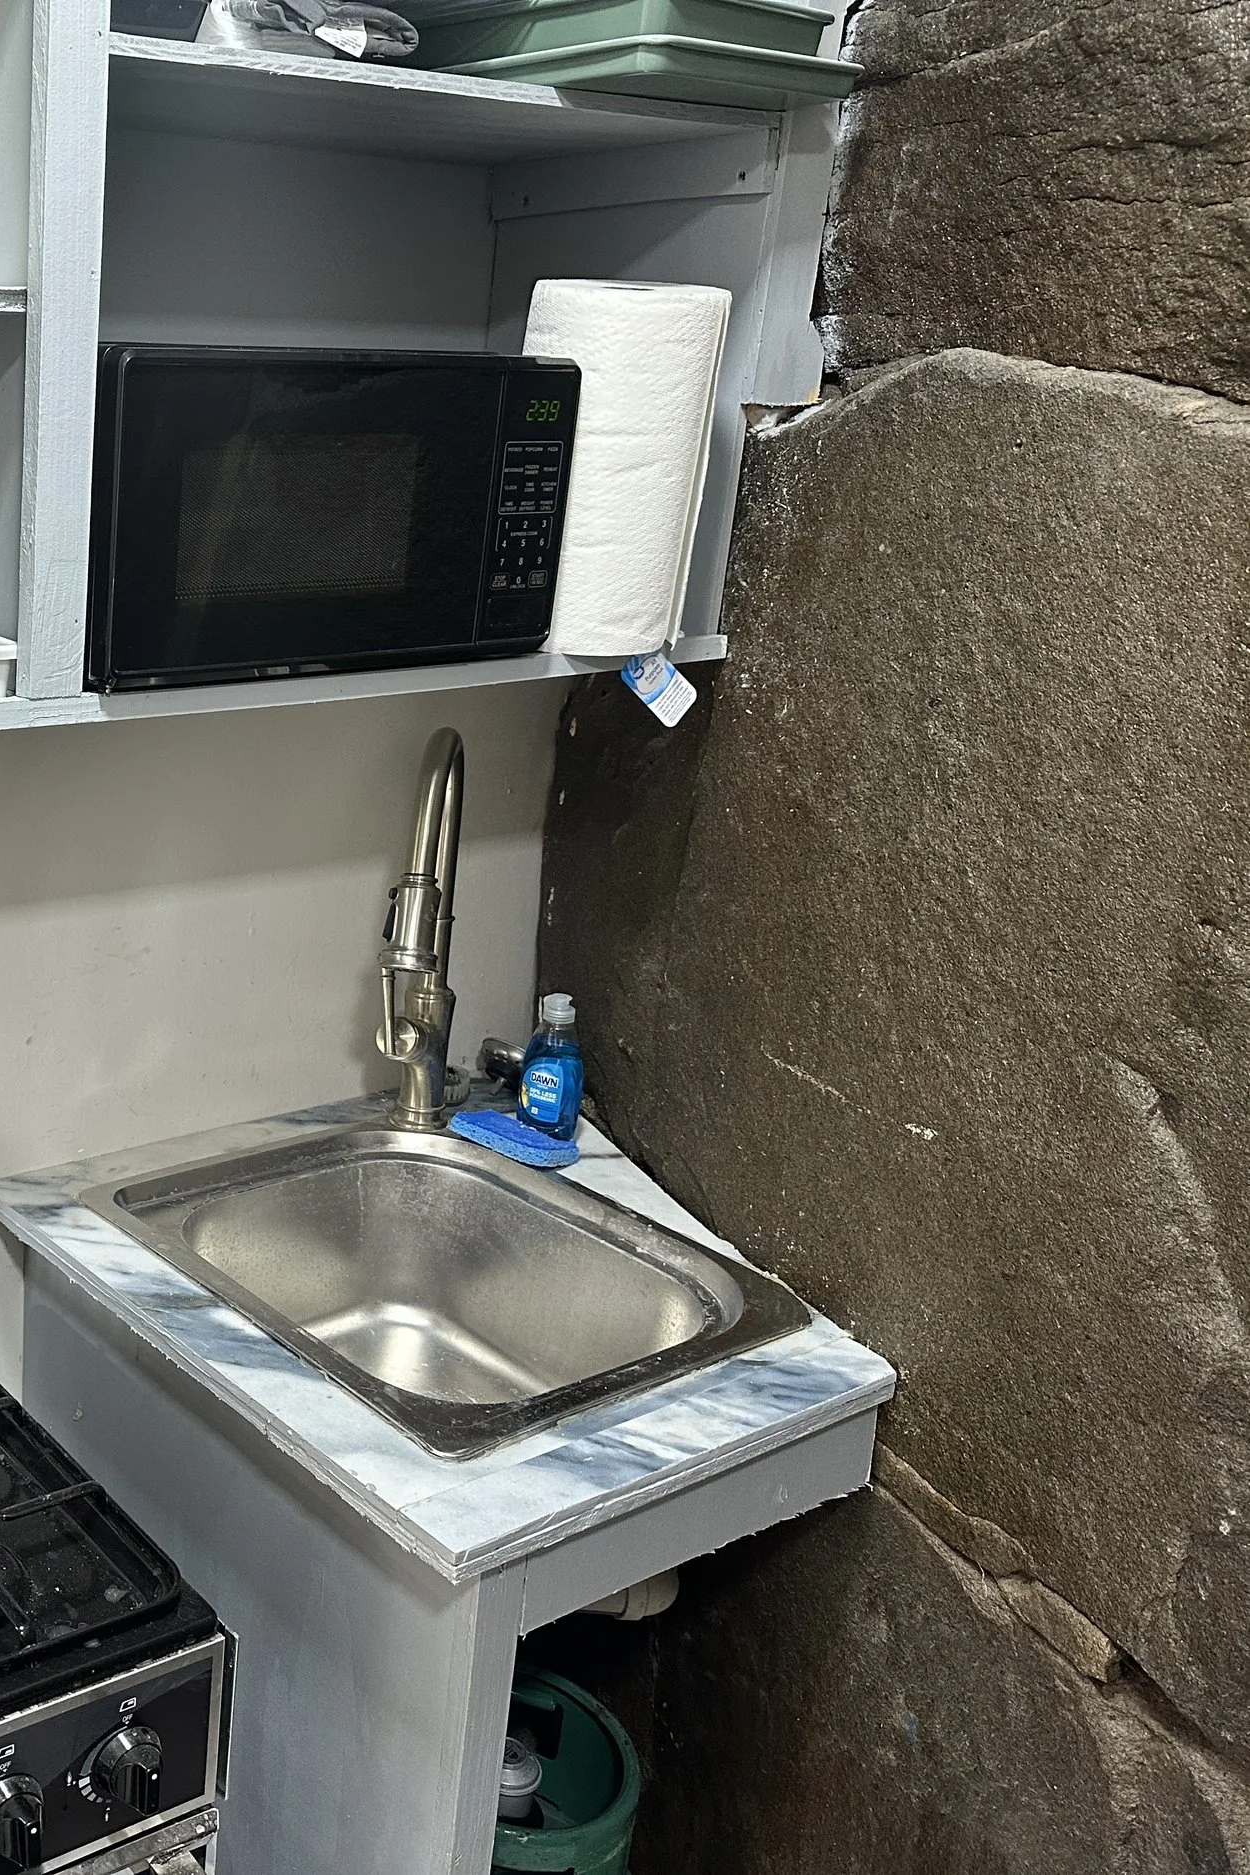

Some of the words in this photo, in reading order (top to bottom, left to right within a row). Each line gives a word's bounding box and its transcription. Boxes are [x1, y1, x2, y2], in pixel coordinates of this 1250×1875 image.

[525, 400, 561, 421] 2:39
[523, 520, 528, 528] 2
[542, 520, 547, 528] 3
[502, 540, 507, 548] 4
[521, 539, 526, 547] 5
[539, 538, 544, 546] 6
[518, 557, 524, 565] 8
[537, 556, 542, 565] 9
[516, 576, 521, 584] 0
[531, 1073, 558, 1087] DAWN
[542, 1091, 557, 1099] LESS
[121, 1714, 134, 1724] OFF
[0, 1761, 12, 1772] OFF
